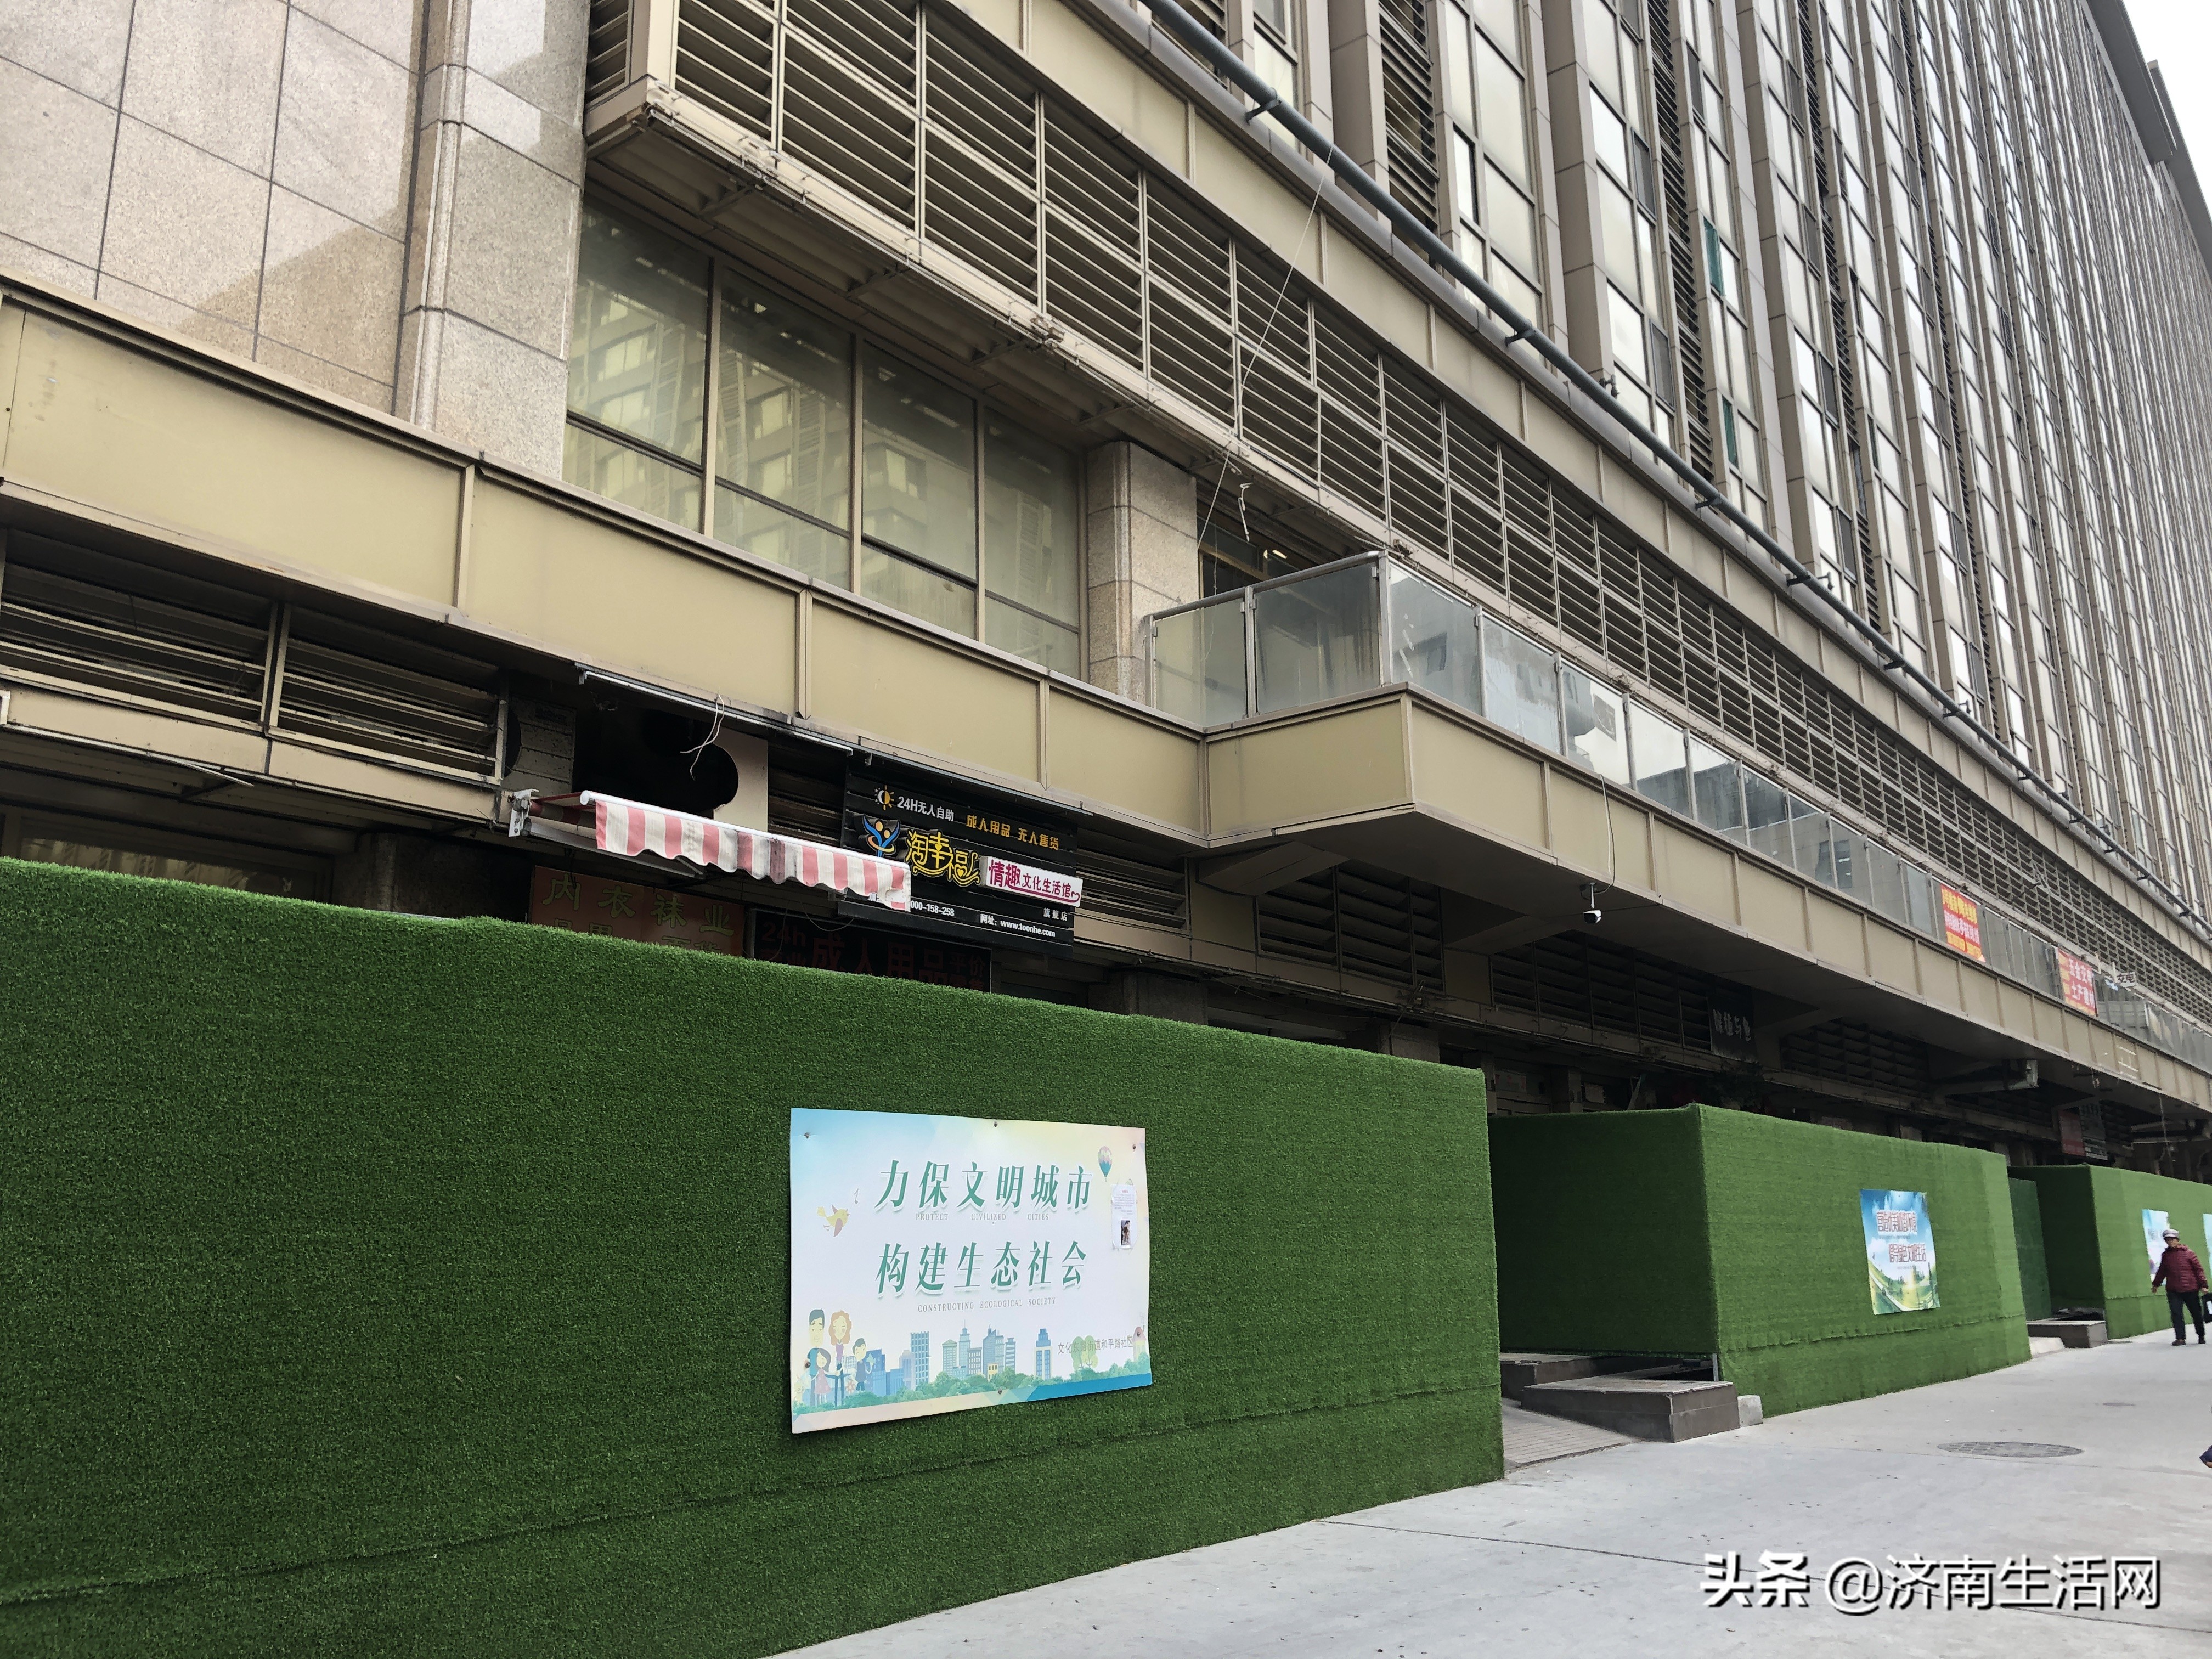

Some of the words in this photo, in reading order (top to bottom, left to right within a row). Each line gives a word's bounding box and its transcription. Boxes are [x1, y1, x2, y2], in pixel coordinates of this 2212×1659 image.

[897, 795, 954, 821] 24H无人自助
[966, 815, 1011, 837] 成人用品
[1017, 828, 1059, 850] 无人售货
[905, 831, 980, 885] 淘幸福
[542, 873, 735, 937] 内衣袜业
[1043, 907, 1067, 922] 旗舰店
[762, 922, 806, 948] 24h
[1000, 920, 1056, 938] www.toonhe.com
[874, 1159, 1092, 1209] 力保文明城市
[971, 1212, 1006, 1221] CIVILIZED
[874, 1240, 1086, 1294] 构建生态社会
[918, 1301, 974, 1312] CONSTRUCTING
[980, 1299, 1023, 1309] ECOLOGICAL
[1028, 1297, 1056, 1306] SOCIETY
[1058, 1335, 1133, 1355] 文化东路街道和平路社区
